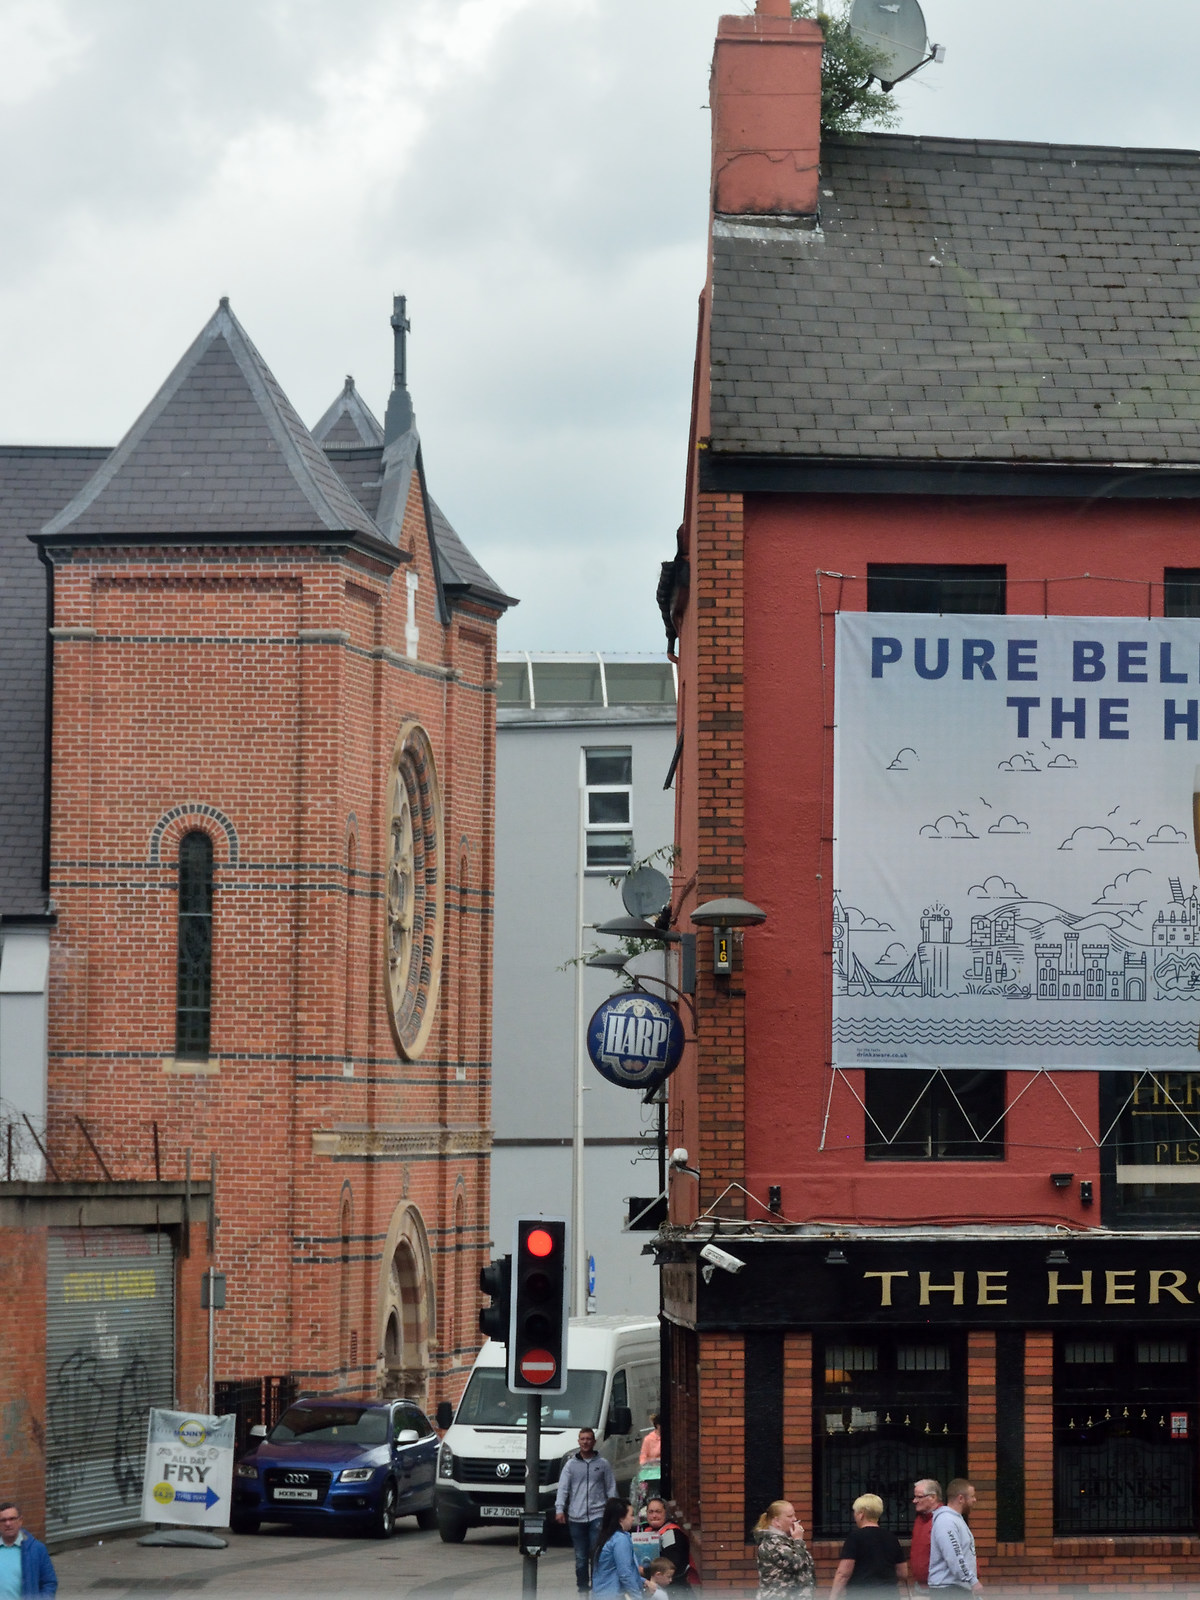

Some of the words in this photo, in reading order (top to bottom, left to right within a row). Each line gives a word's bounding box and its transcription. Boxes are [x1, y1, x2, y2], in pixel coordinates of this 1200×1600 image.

[871, 636, 1039, 683] PURE
[1006, 695, 1130, 741] THE
[606, 1015, 668, 1058] HARP
[864, 1270, 1009, 1306] THE
[164, 1464, 212, 1483] FRY
[172, 1456, 188, 1464] ALL
[190, 1456, 206, 1465] DAY
[484, 1508, 498, 1516] UFZ
[500, 1508, 520, 1516] 7060
